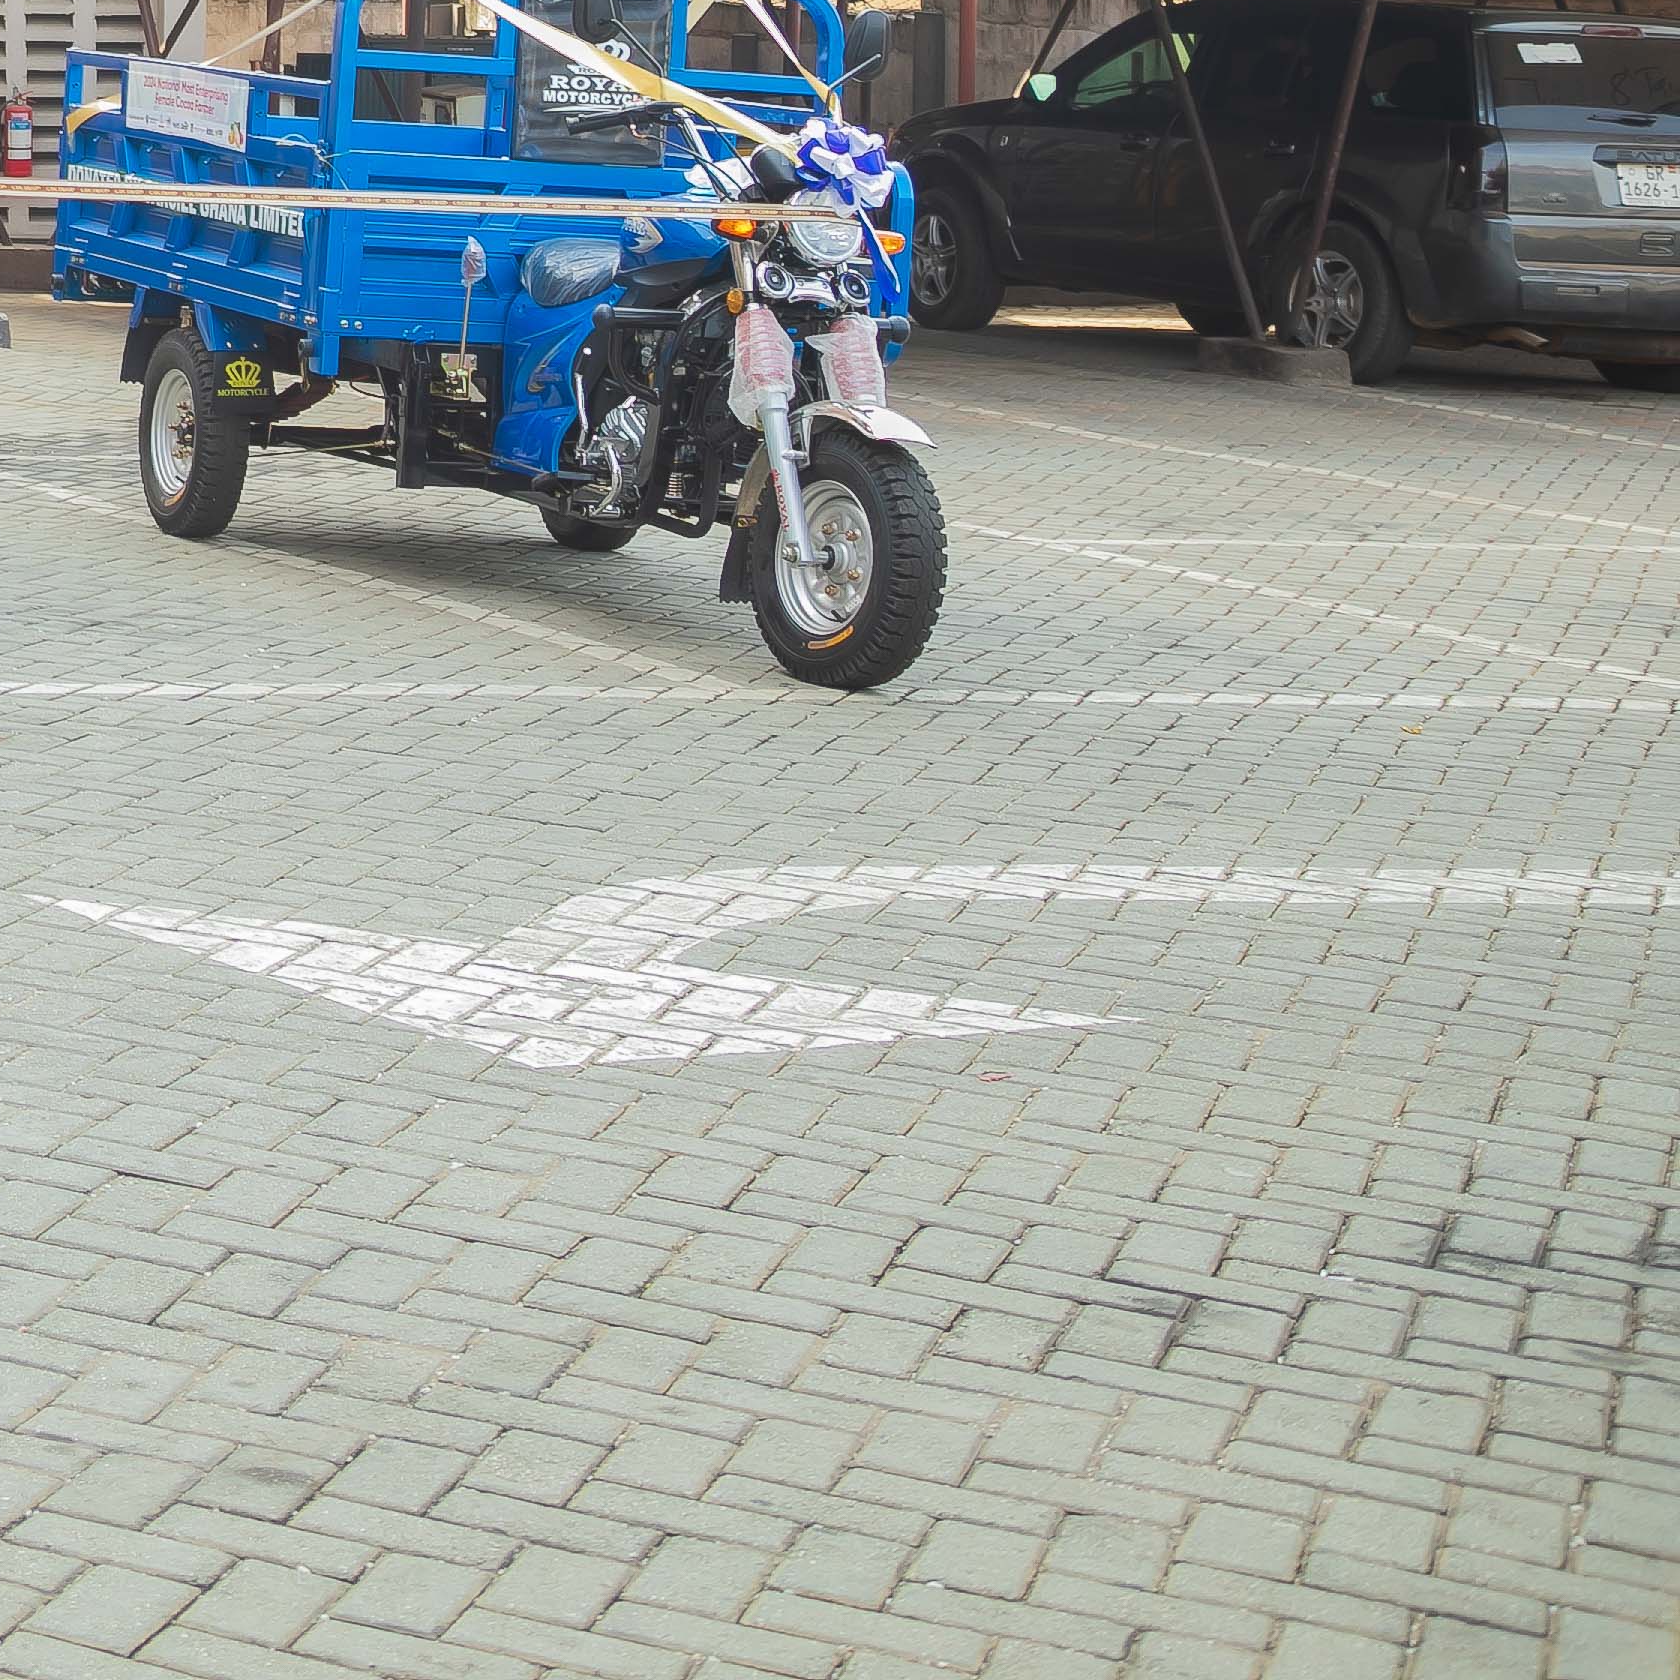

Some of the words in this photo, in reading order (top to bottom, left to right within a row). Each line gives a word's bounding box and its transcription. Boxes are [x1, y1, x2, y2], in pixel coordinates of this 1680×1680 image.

[550, 74, 635, 93] ROYA
[1624, 181, 1680, 199] 1626-1
[217, 388, 270, 397] MOTORCYCLE
